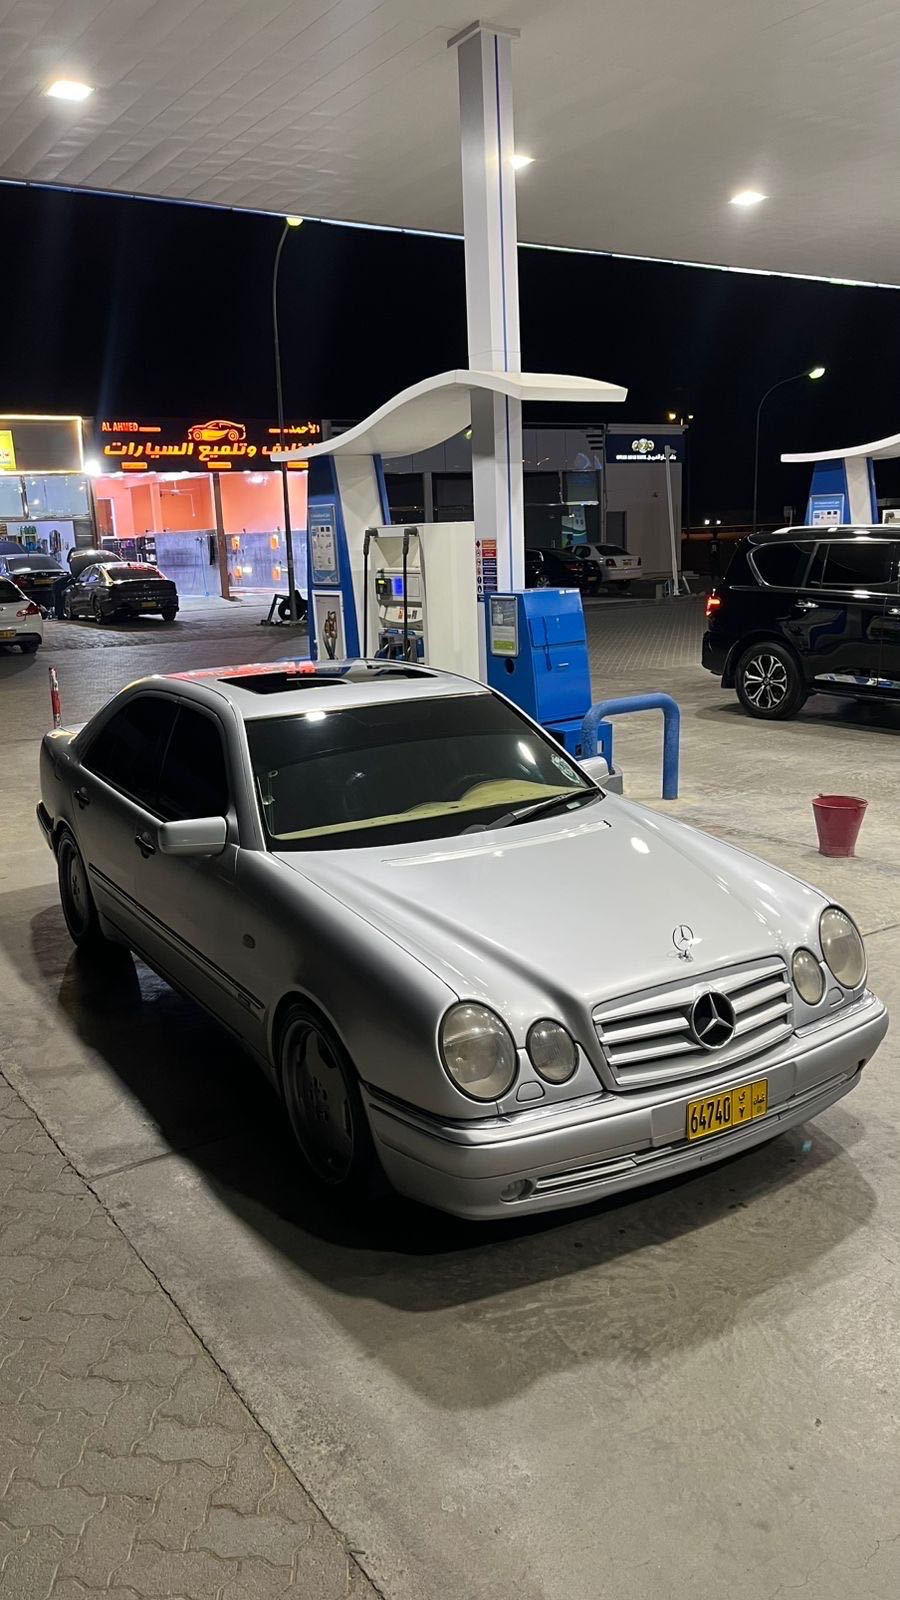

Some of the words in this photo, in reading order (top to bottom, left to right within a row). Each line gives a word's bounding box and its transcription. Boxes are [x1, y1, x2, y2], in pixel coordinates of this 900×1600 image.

[101, 421, 111, 431] AL
[104, 442, 194, 459] السيارات
[199, 442, 258, 461] وتلميع
[690, 1097, 731, 1133] 64740
